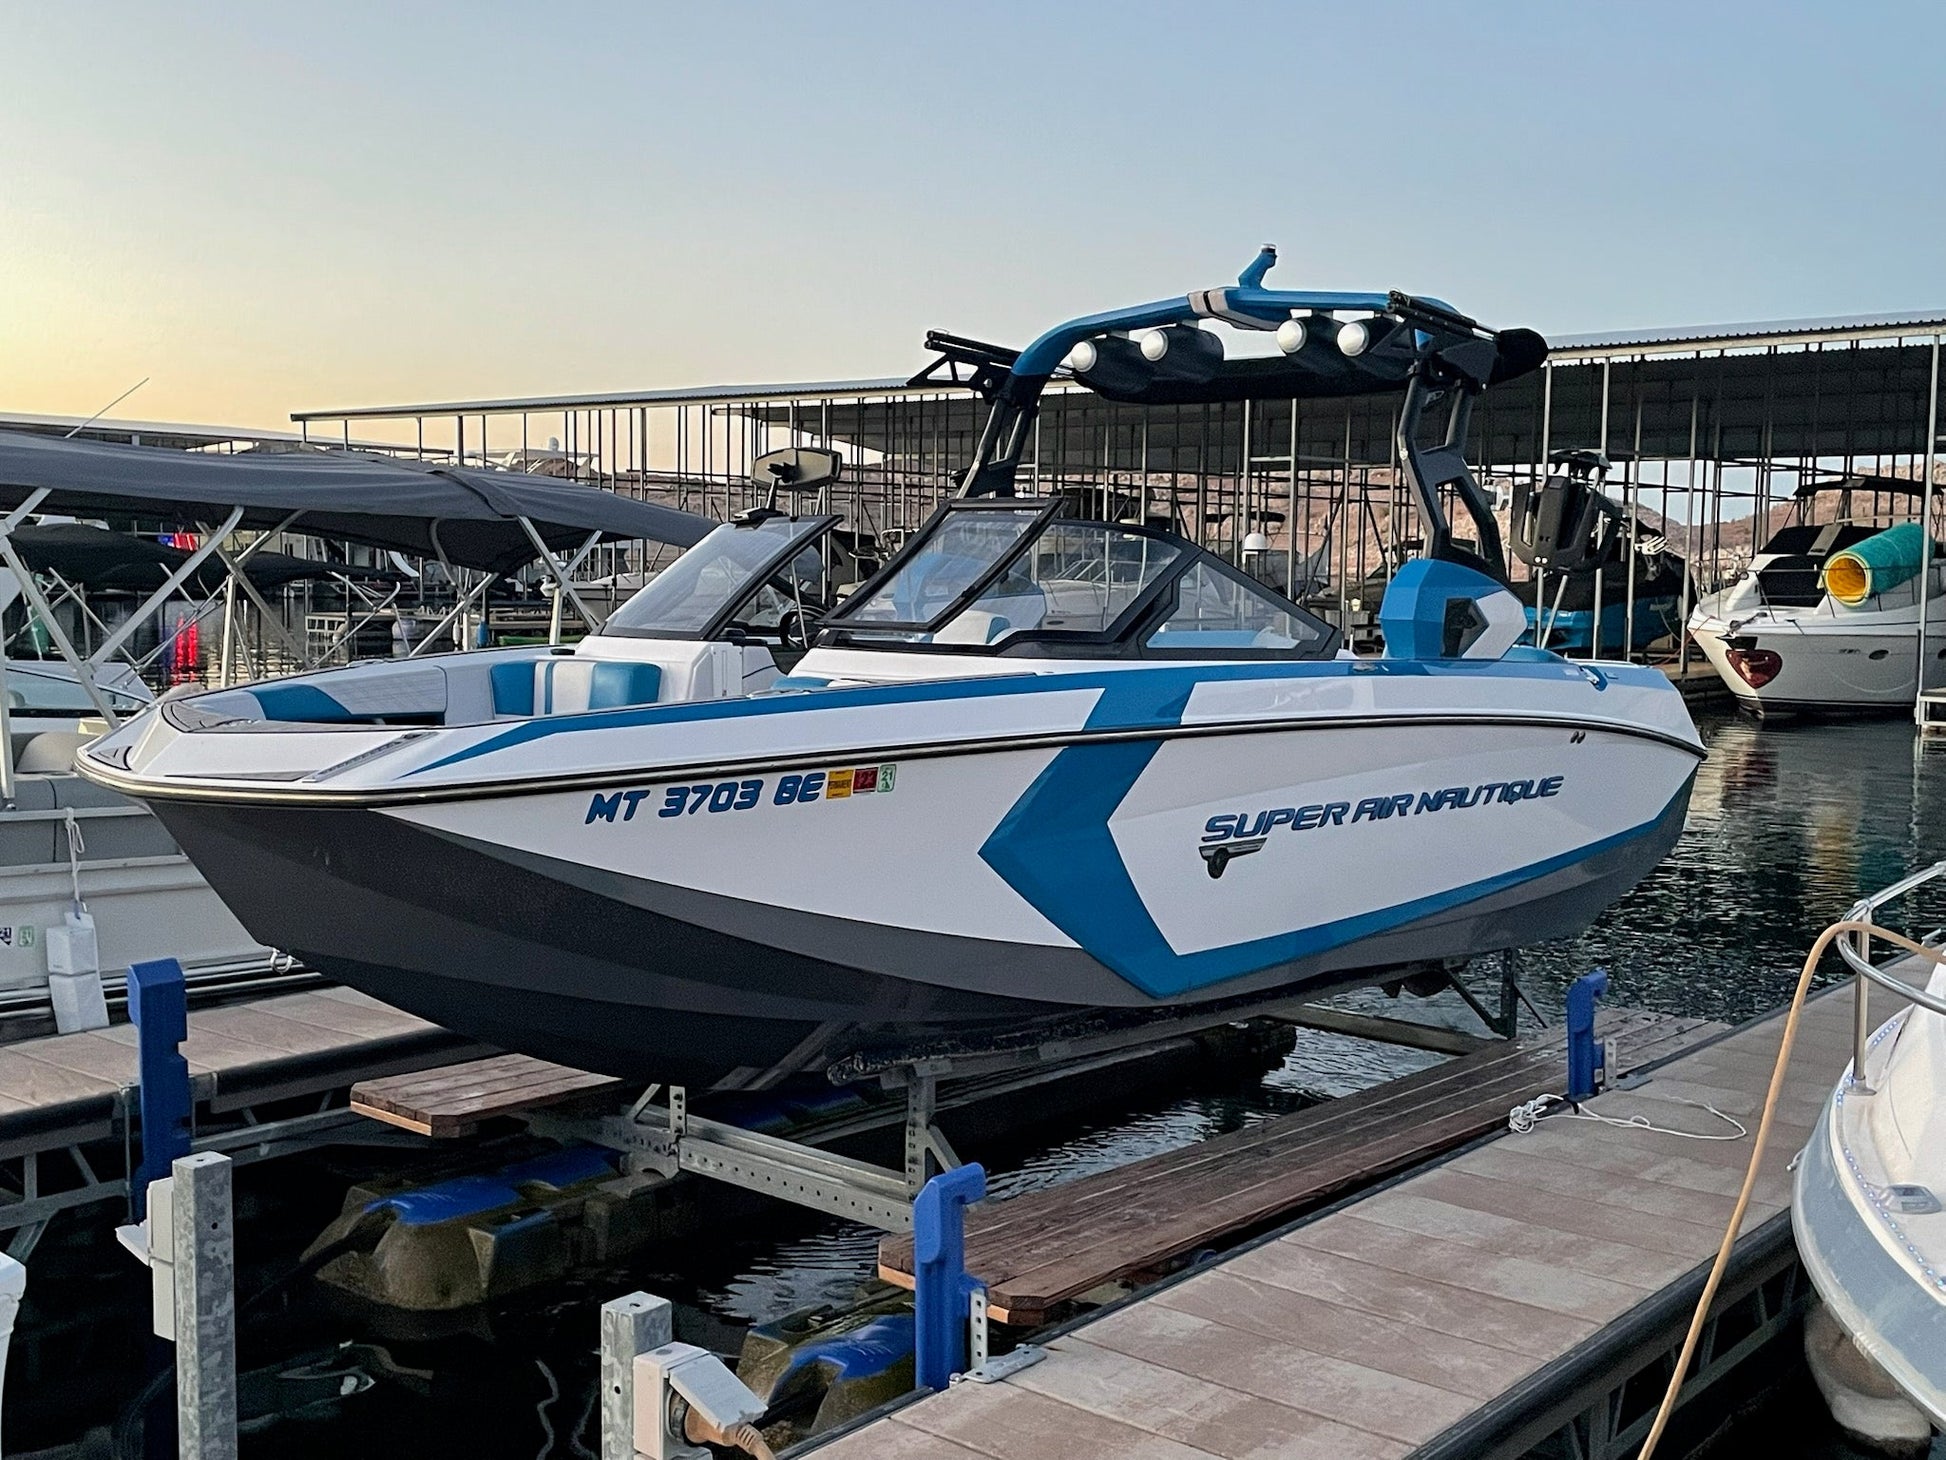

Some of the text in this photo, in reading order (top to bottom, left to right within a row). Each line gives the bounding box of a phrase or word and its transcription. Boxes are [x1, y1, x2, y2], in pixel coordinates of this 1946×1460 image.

[585, 772, 826, 825] MT 3703 BE
[1201, 775, 1564, 842] SUPER AIR NAUTIQUE
